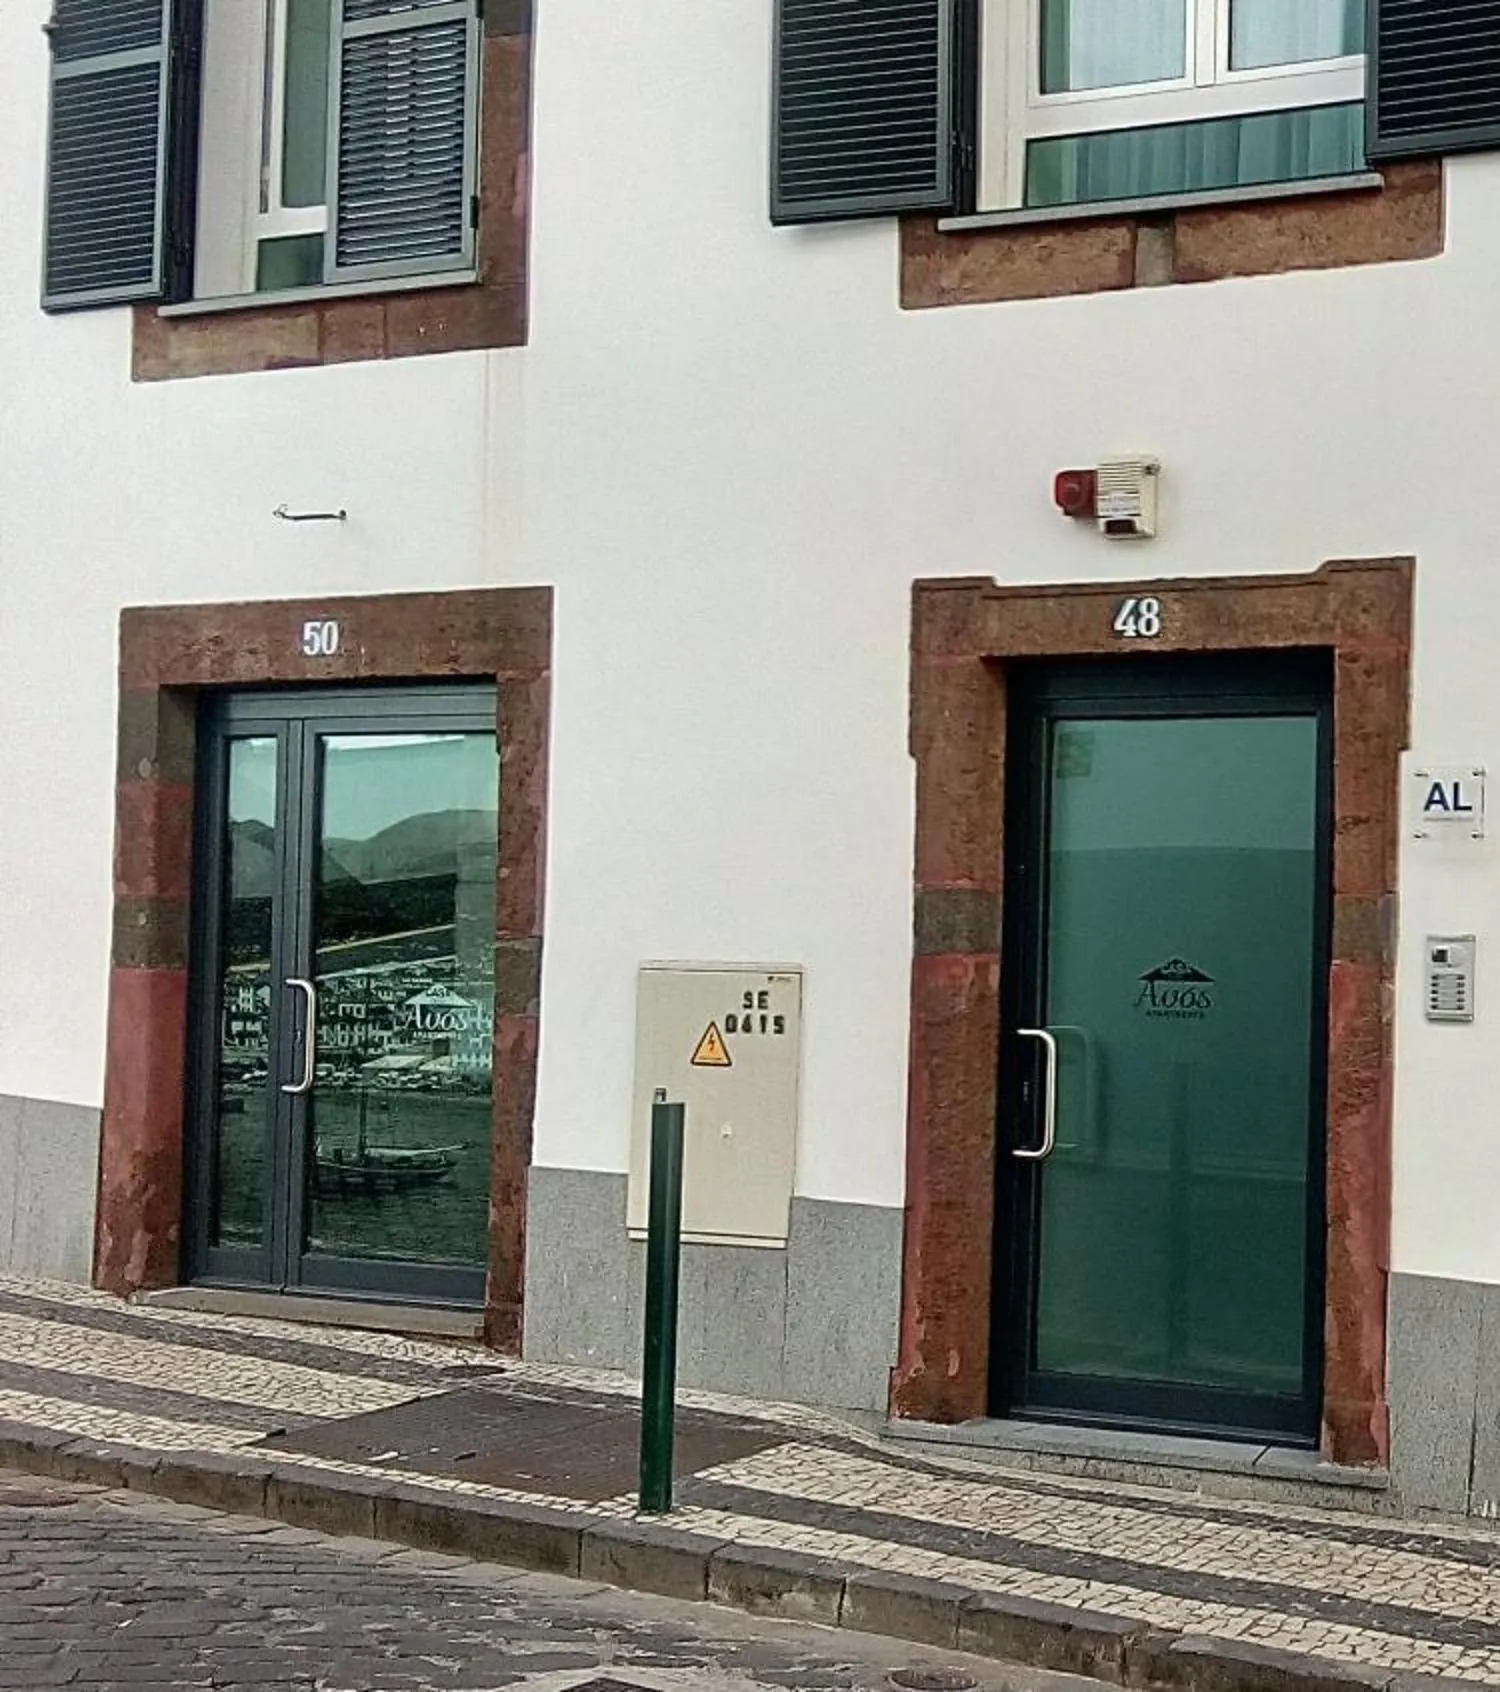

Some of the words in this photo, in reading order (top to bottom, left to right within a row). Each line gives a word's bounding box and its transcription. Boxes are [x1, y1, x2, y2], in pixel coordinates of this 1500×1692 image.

[1113, 598, 1160, 636] 48
[303, 621, 339, 655] 50
[1423, 781, 1472, 812] AL
[742, 990, 769, 1010] SE
